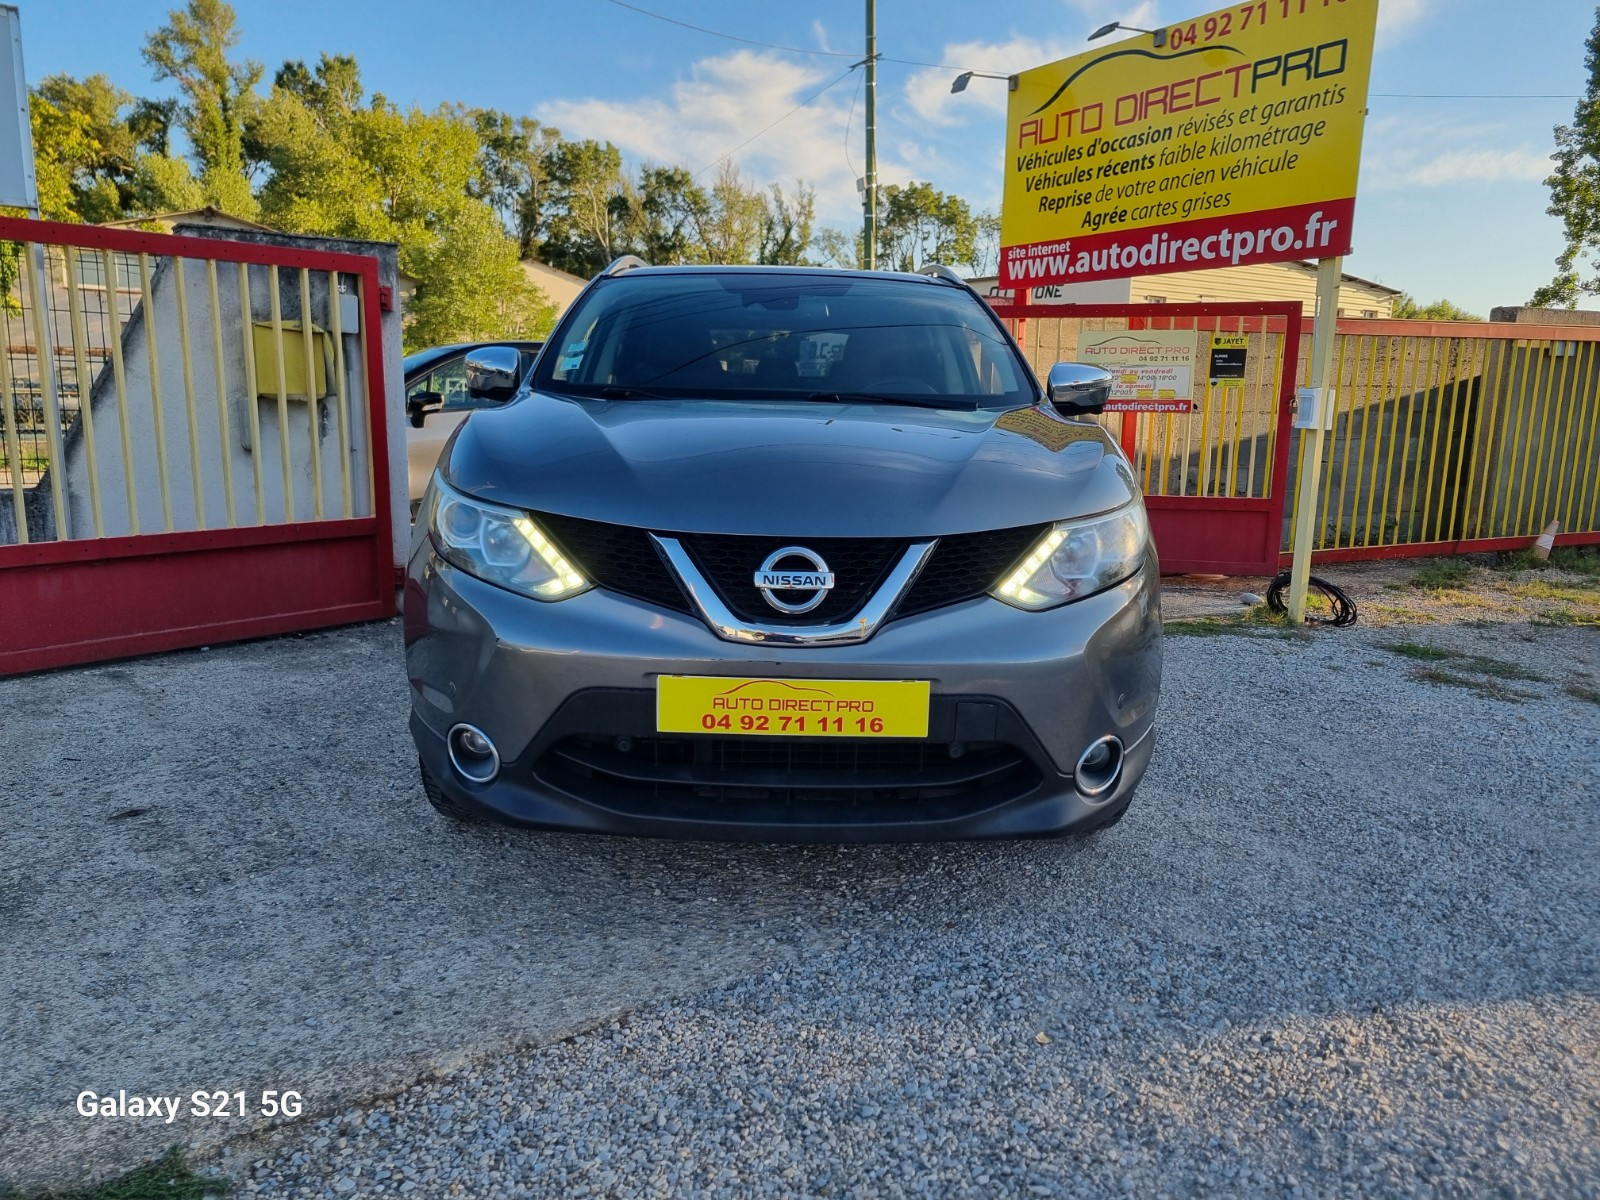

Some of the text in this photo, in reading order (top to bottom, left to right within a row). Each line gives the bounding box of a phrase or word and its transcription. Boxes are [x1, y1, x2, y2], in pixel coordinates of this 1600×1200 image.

[1170, 23, 1197, 50] 04
[1204, 12, 1232, 41] 92
[1240, 1, 1267, 30] 71
[1017, 84, 1346, 172] Véhicules d'occasion révisés et garantis
[1019, 102, 1103, 149] AUTO
[1026, 120, 1326, 192] Véhicules récents faible kilométrage
[1038, 150, 1299, 214] Reprise de votre ancien véhicule
[1081, 192, 1232, 231] Agrée cartes grises
[1008, 211, 1338, 280] www.autodirectpro.fr
[1008, 240, 1071, 260] site internet
[1085, 347, 1117, 355] AUTO
[1120, 347, 1163, 355] DIRECT
[1223, 337, 1244, 345] JAYET
[1103, 402, 1188, 412] .autodirectpro.fr
[763, 575, 827, 586] NISSAN
[713, 697, 764, 711] AUTO
[702, 714, 883, 733] 04 92 71 11 16
